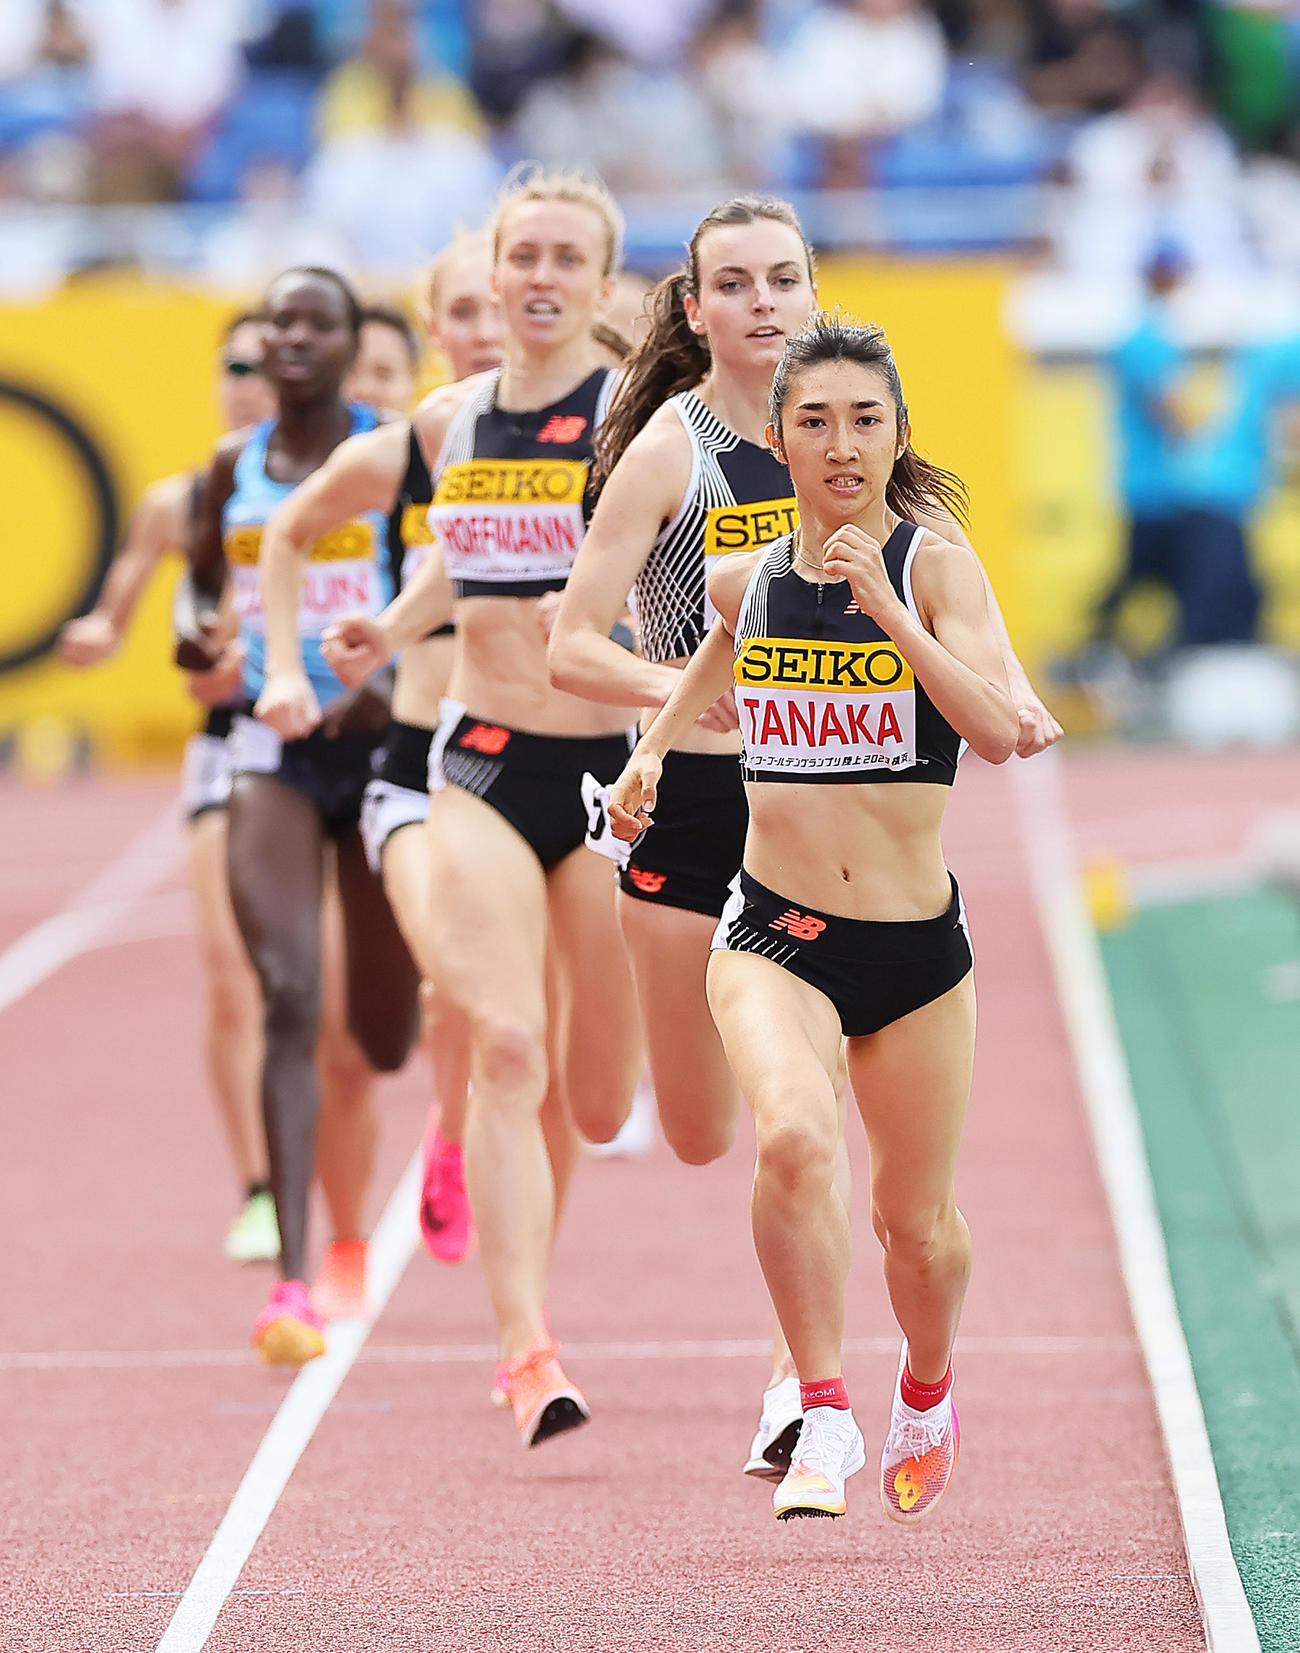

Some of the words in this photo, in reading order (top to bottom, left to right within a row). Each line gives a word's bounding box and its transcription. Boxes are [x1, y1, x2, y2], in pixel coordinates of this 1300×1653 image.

[444, 467, 575, 500] SEIKO
[438, 515, 577, 554] HOFFMANN
[715, 508, 795, 548] SEI
[741, 645, 903, 686] SEIKO
[743, 698, 904, 748] TANAKA
